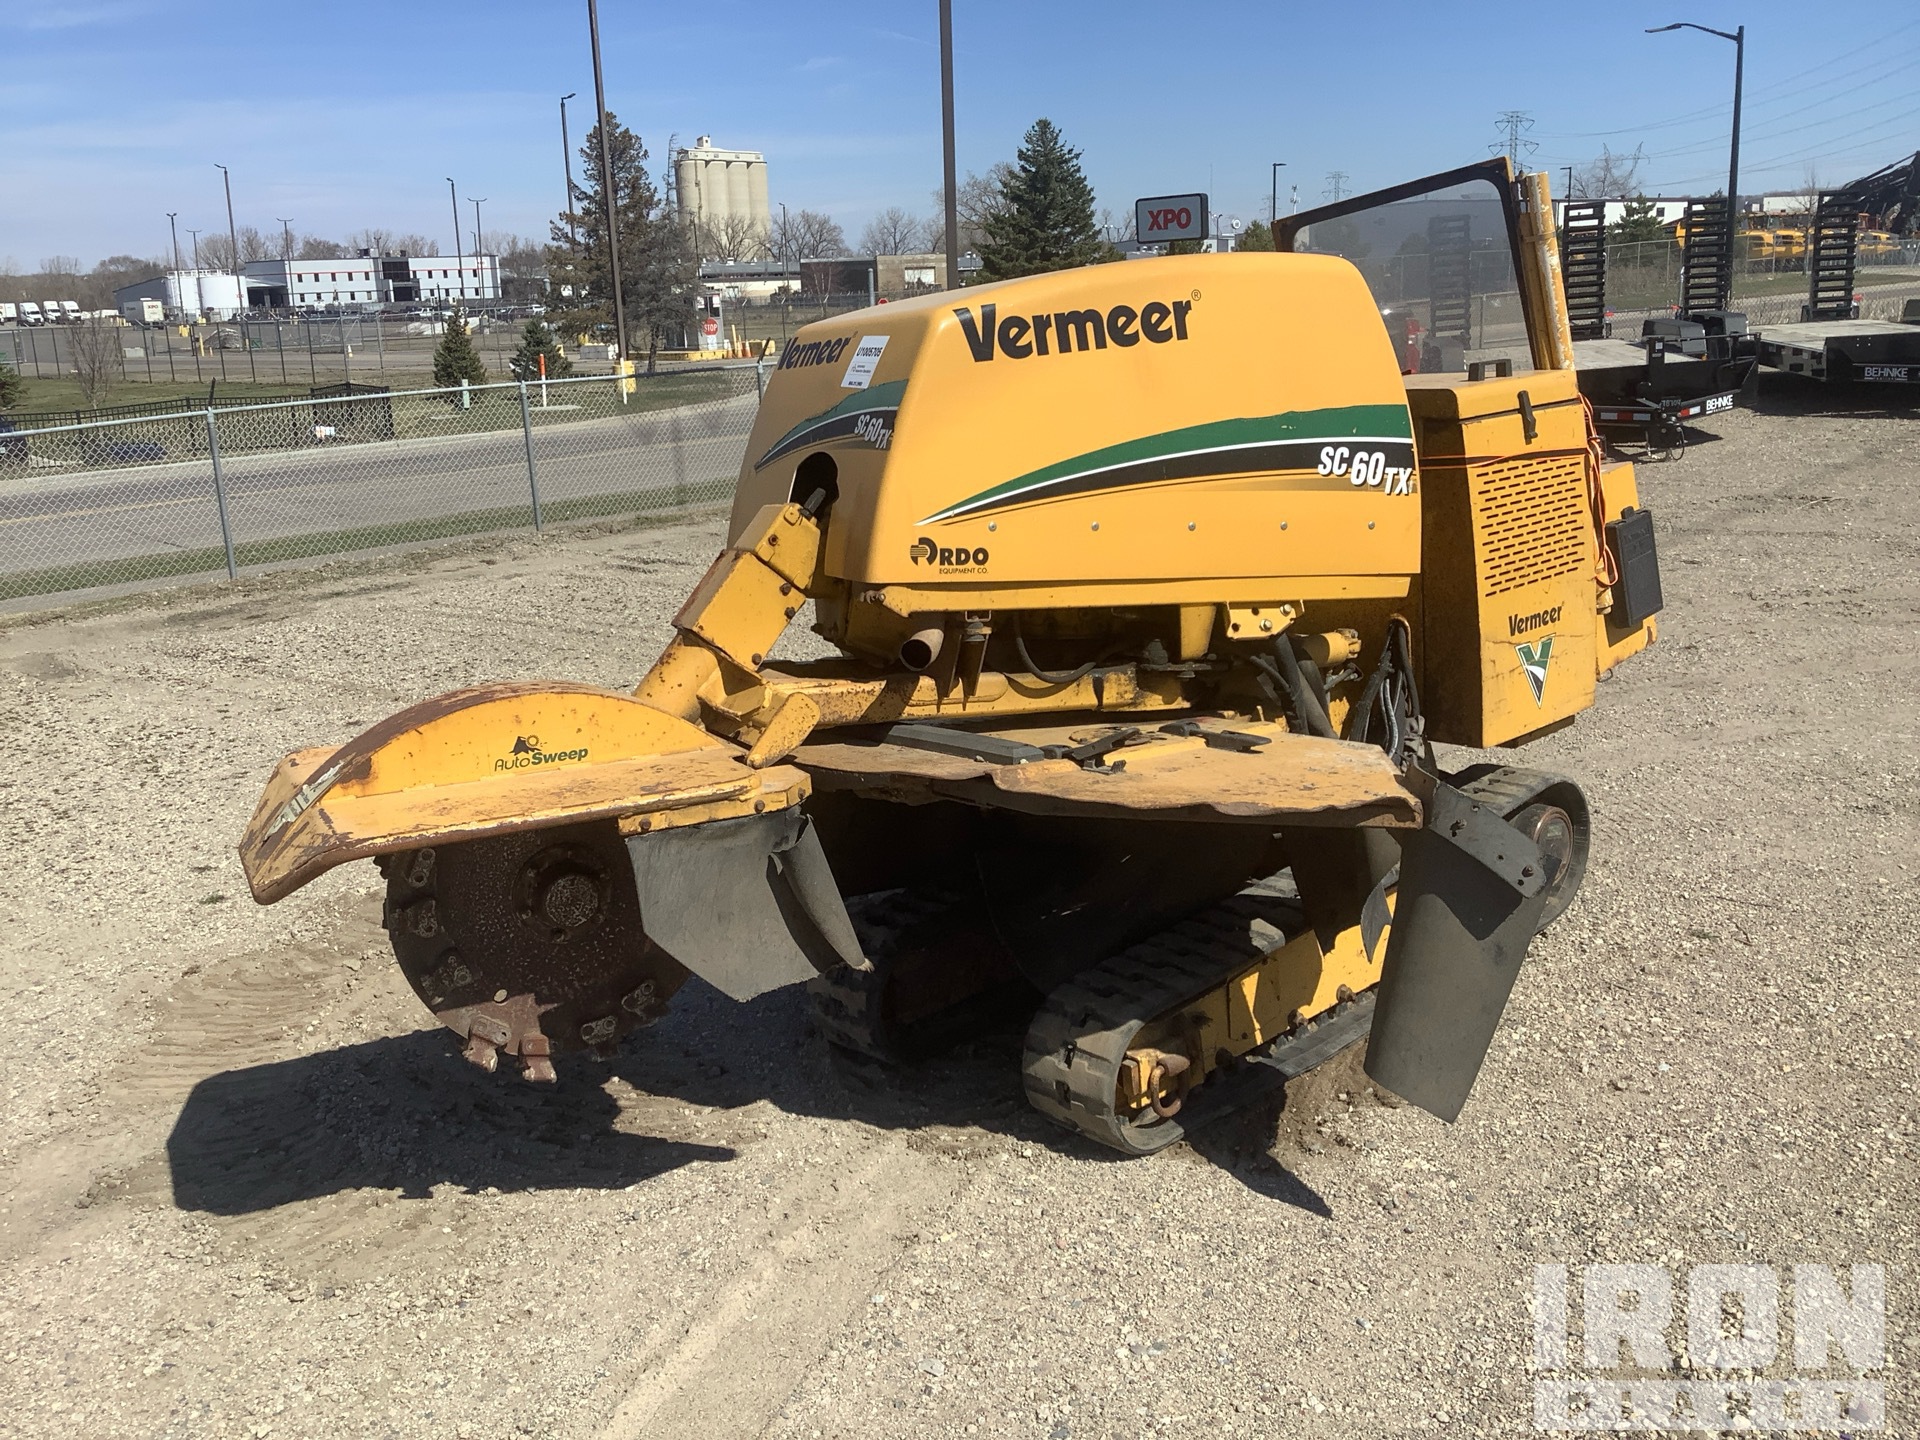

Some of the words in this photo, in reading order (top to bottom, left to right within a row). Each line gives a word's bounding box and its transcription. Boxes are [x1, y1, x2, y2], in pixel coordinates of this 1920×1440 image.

[1147, 207, 1192, 231] XPO
[704, 324, 718, 332] STOP
[1864, 367, 1909, 378] BEHNKE
[1705, 394, 1734, 411] BEHNKE
[939, 567, 976, 575] EQUIPMENT
[1508, 605, 1563, 637] Vermeer
[494, 748, 589, 772] AutoSweep
